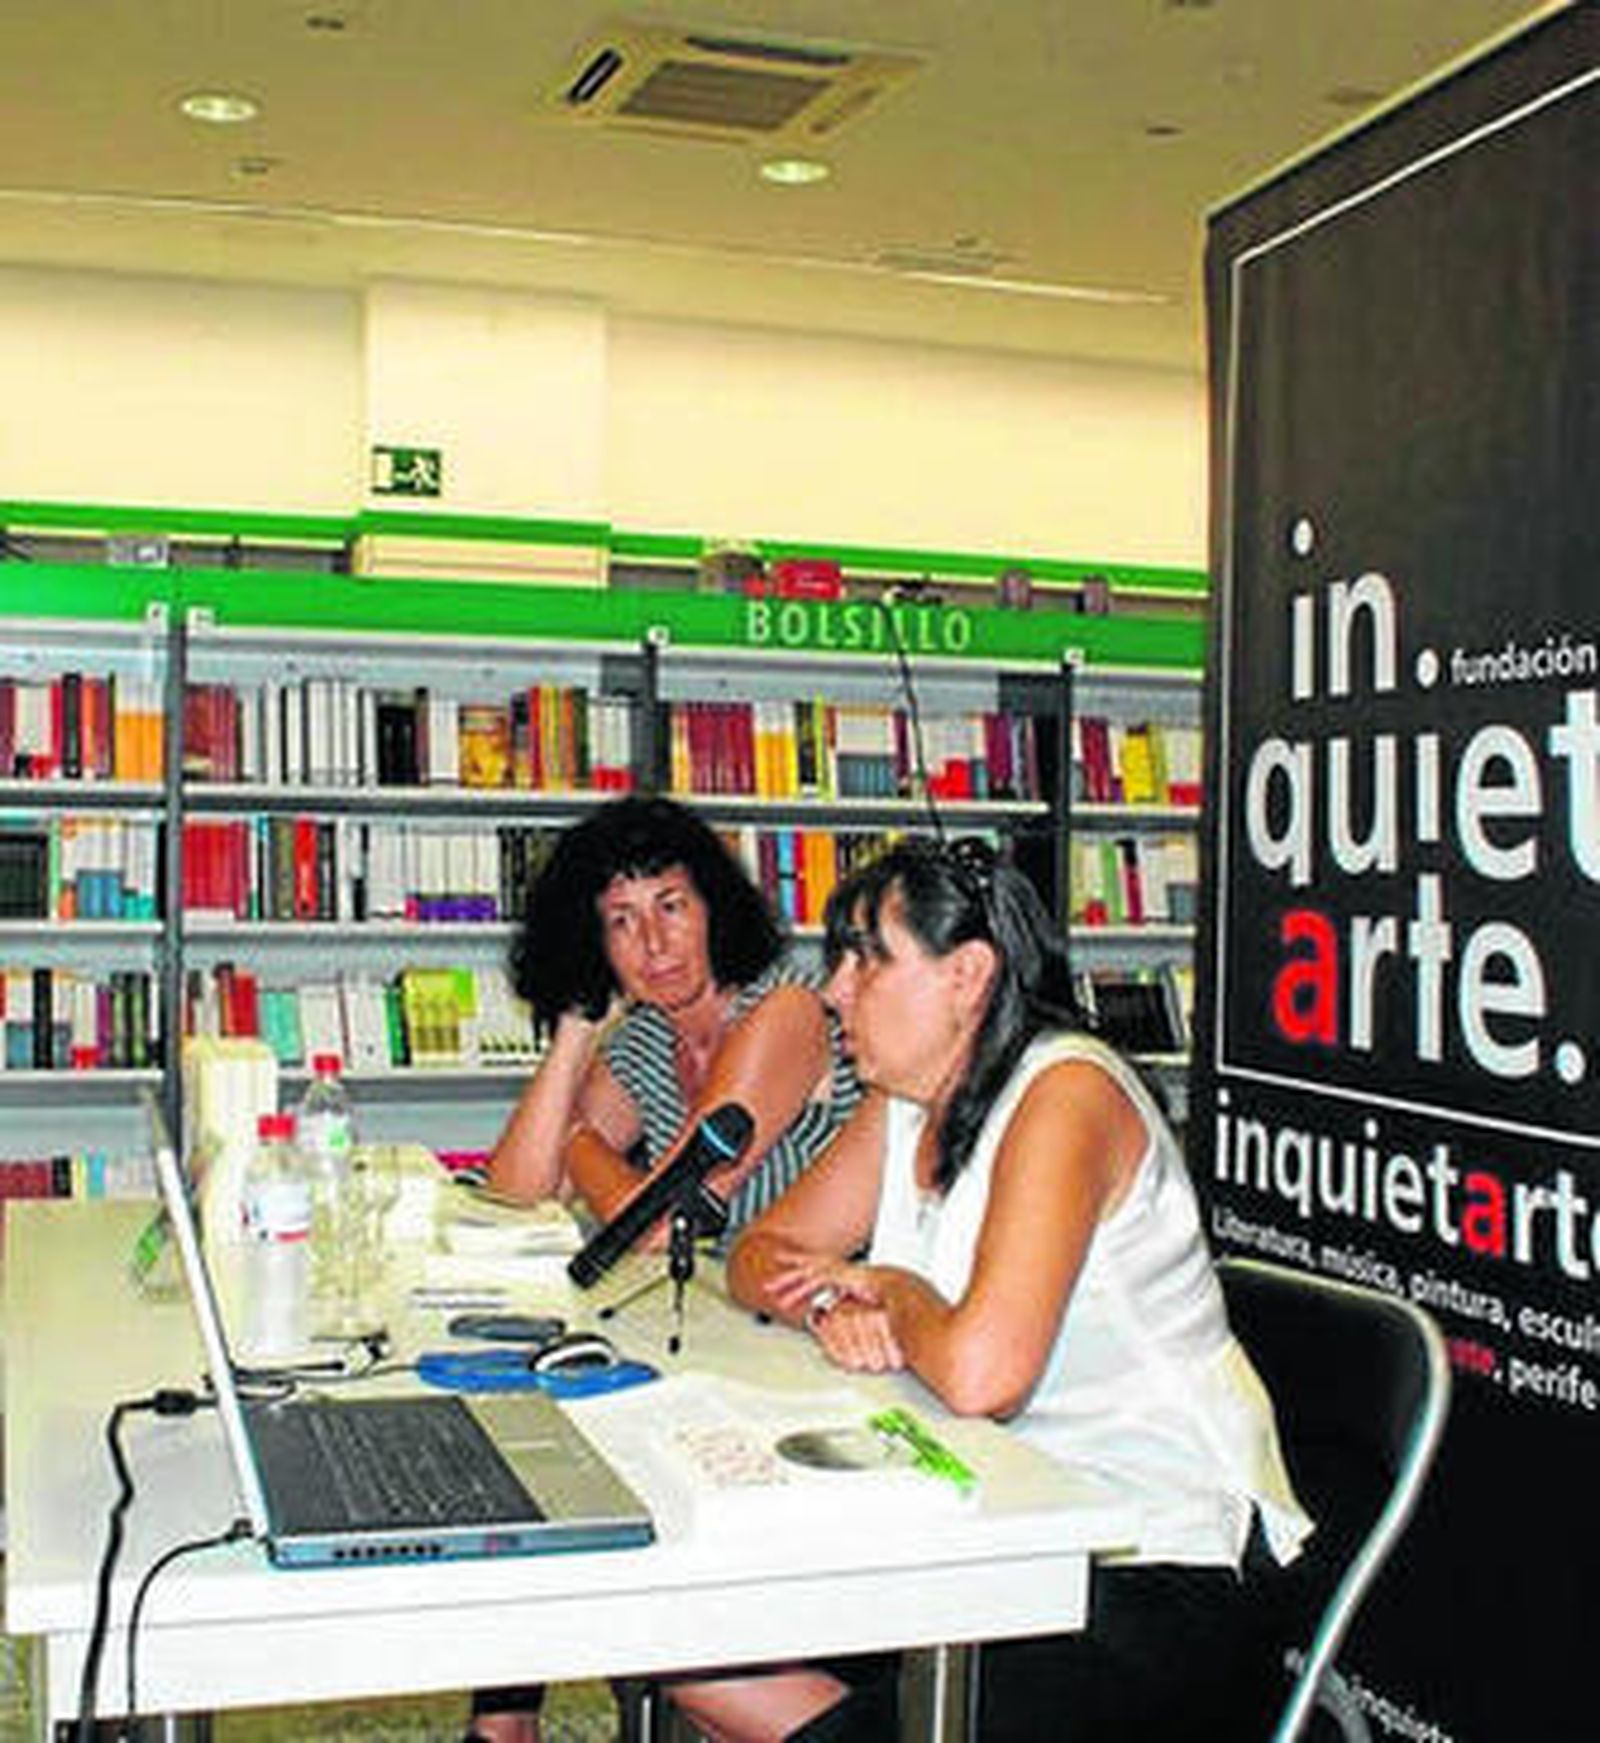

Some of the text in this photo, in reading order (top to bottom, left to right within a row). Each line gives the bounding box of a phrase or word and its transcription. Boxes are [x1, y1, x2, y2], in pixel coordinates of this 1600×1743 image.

[747, 601, 971, 651] BOLSILLO
[1450, 640, 1597, 684] fundación
[1272, 872, 1587, 1084] arte.
[1214, 1088, 1600, 1279] inquietart
